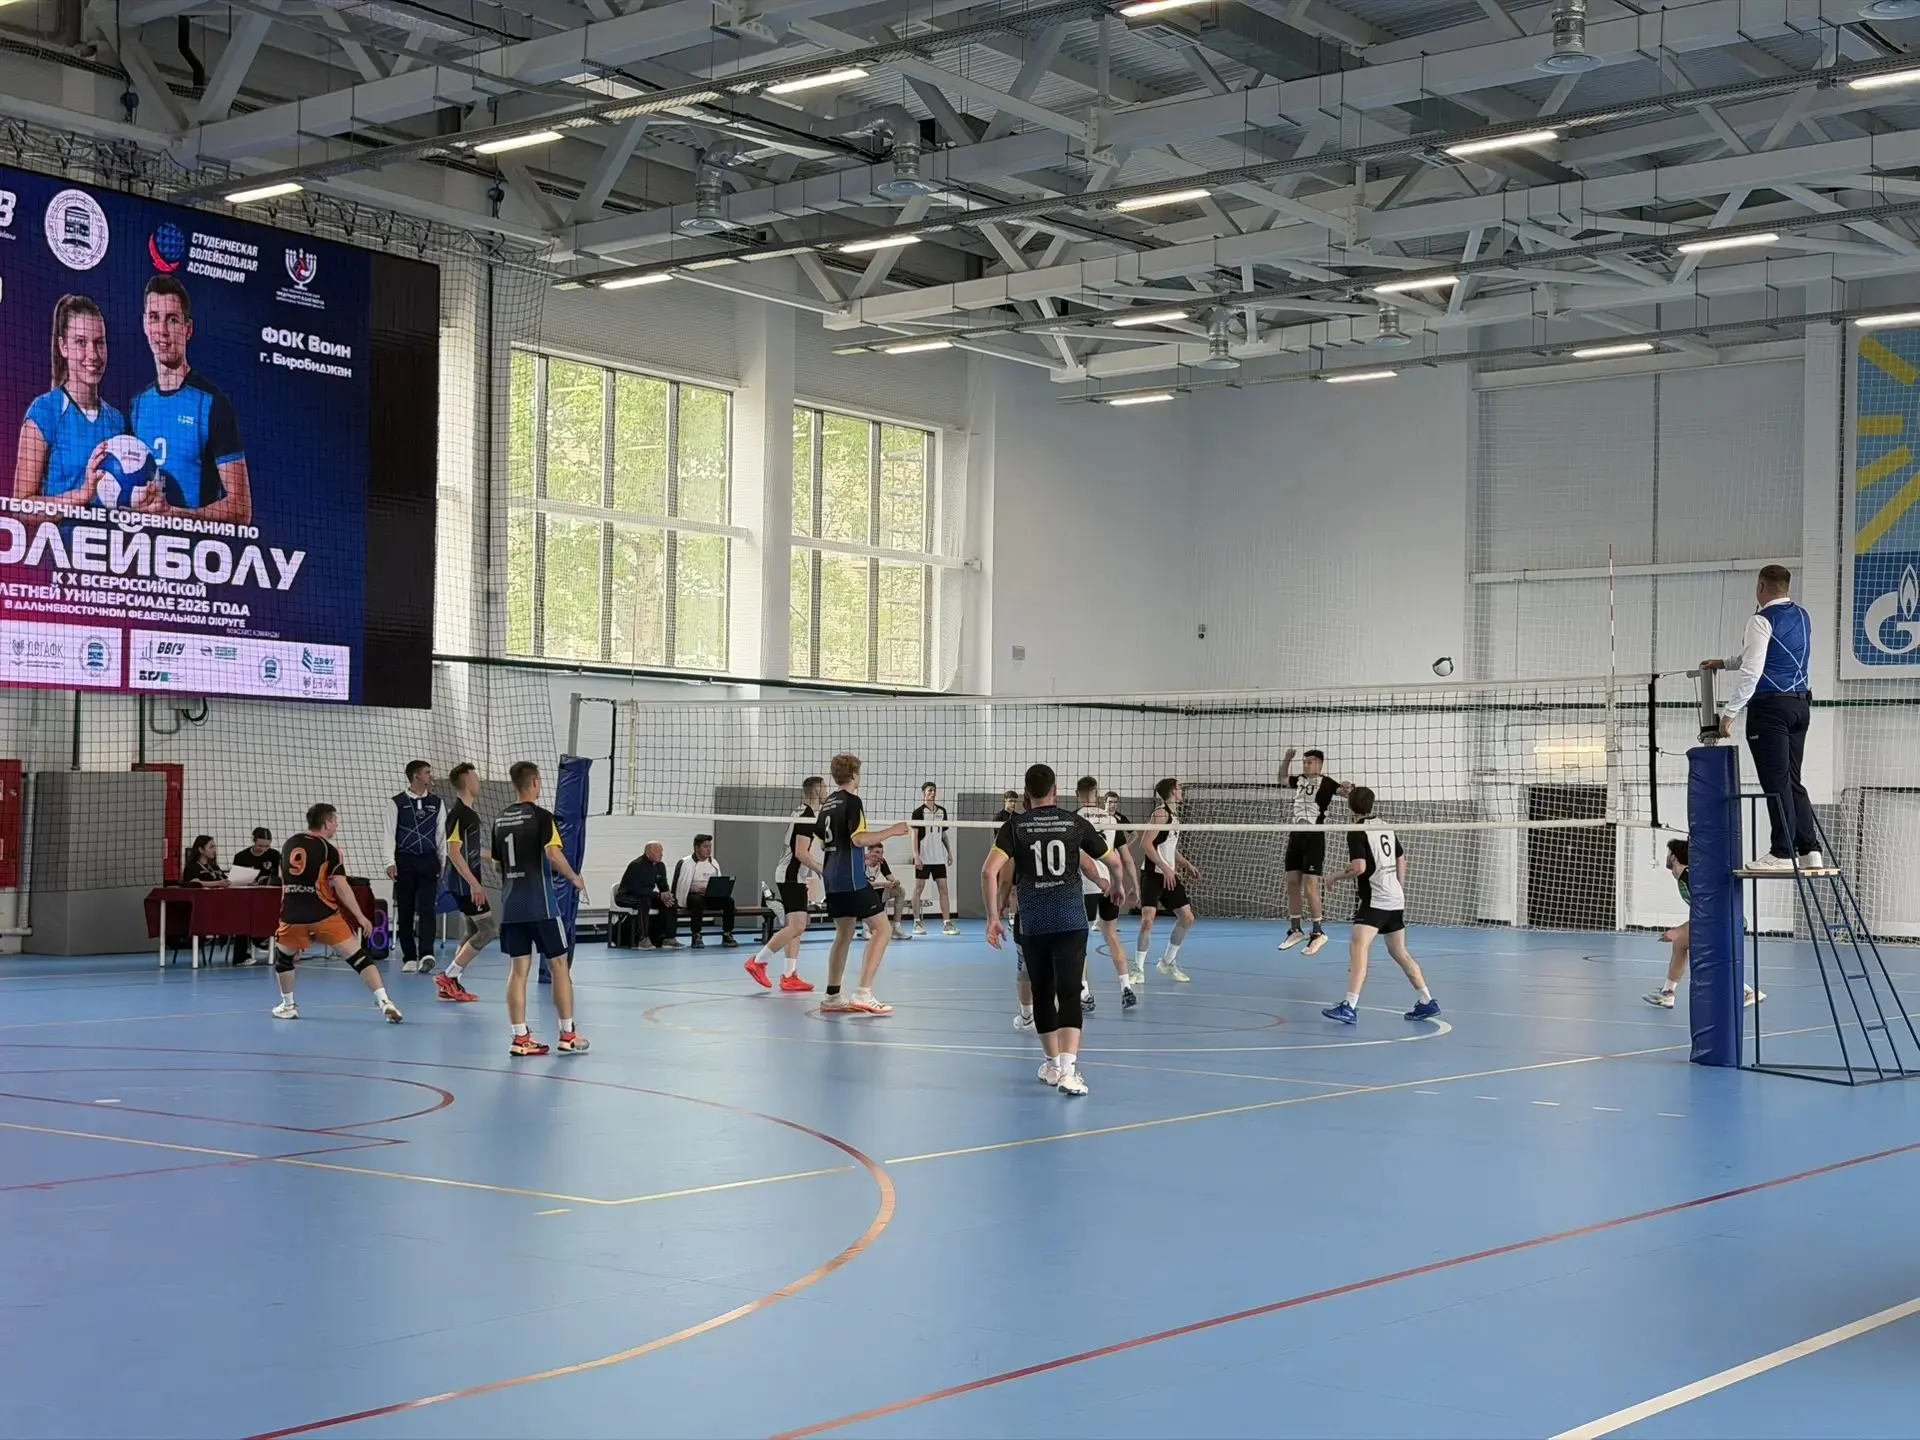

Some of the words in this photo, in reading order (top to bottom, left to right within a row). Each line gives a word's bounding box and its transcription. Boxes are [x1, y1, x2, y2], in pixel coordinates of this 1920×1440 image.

[191, 232, 259, 257] СТУДЕНЧЕСКАЯ
[187, 261, 246, 283] АССОЦИАЦИЯ
[189, 246, 259, 272] ВОЛЕЙБОЛЬНАЯ
[261, 326, 306, 350] ФОК
[308, 335, 352, 358] Воин
[259, 352, 270, 363] г.
[272, 352, 352, 378] Биробиджан
[109, 509, 236, 537] СОРЕВНОВАНИЯ
[238, 525, 260, 539] ПО
[81, 574, 206, 597] ВСЕРОССИЙСКОЙ
[5, 599, 13, 609] В
[14, 601, 126, 617] ДАЛЬНЕВОСТОЧНОМ
[128, 609, 207, 625] ФЕДЕРАЛЬНОМ
[208, 616, 246, 628] ОКРУГЕ
[64, 588, 175, 611] УНИВЕРСИАДЕ
[213, 601, 250, 616] ГОДА
[504, 833, 516, 867] 1
[1030, 840, 1066, 876] 10
[1380, 834, 1392, 857] 6
[289, 847, 307, 876] 9
